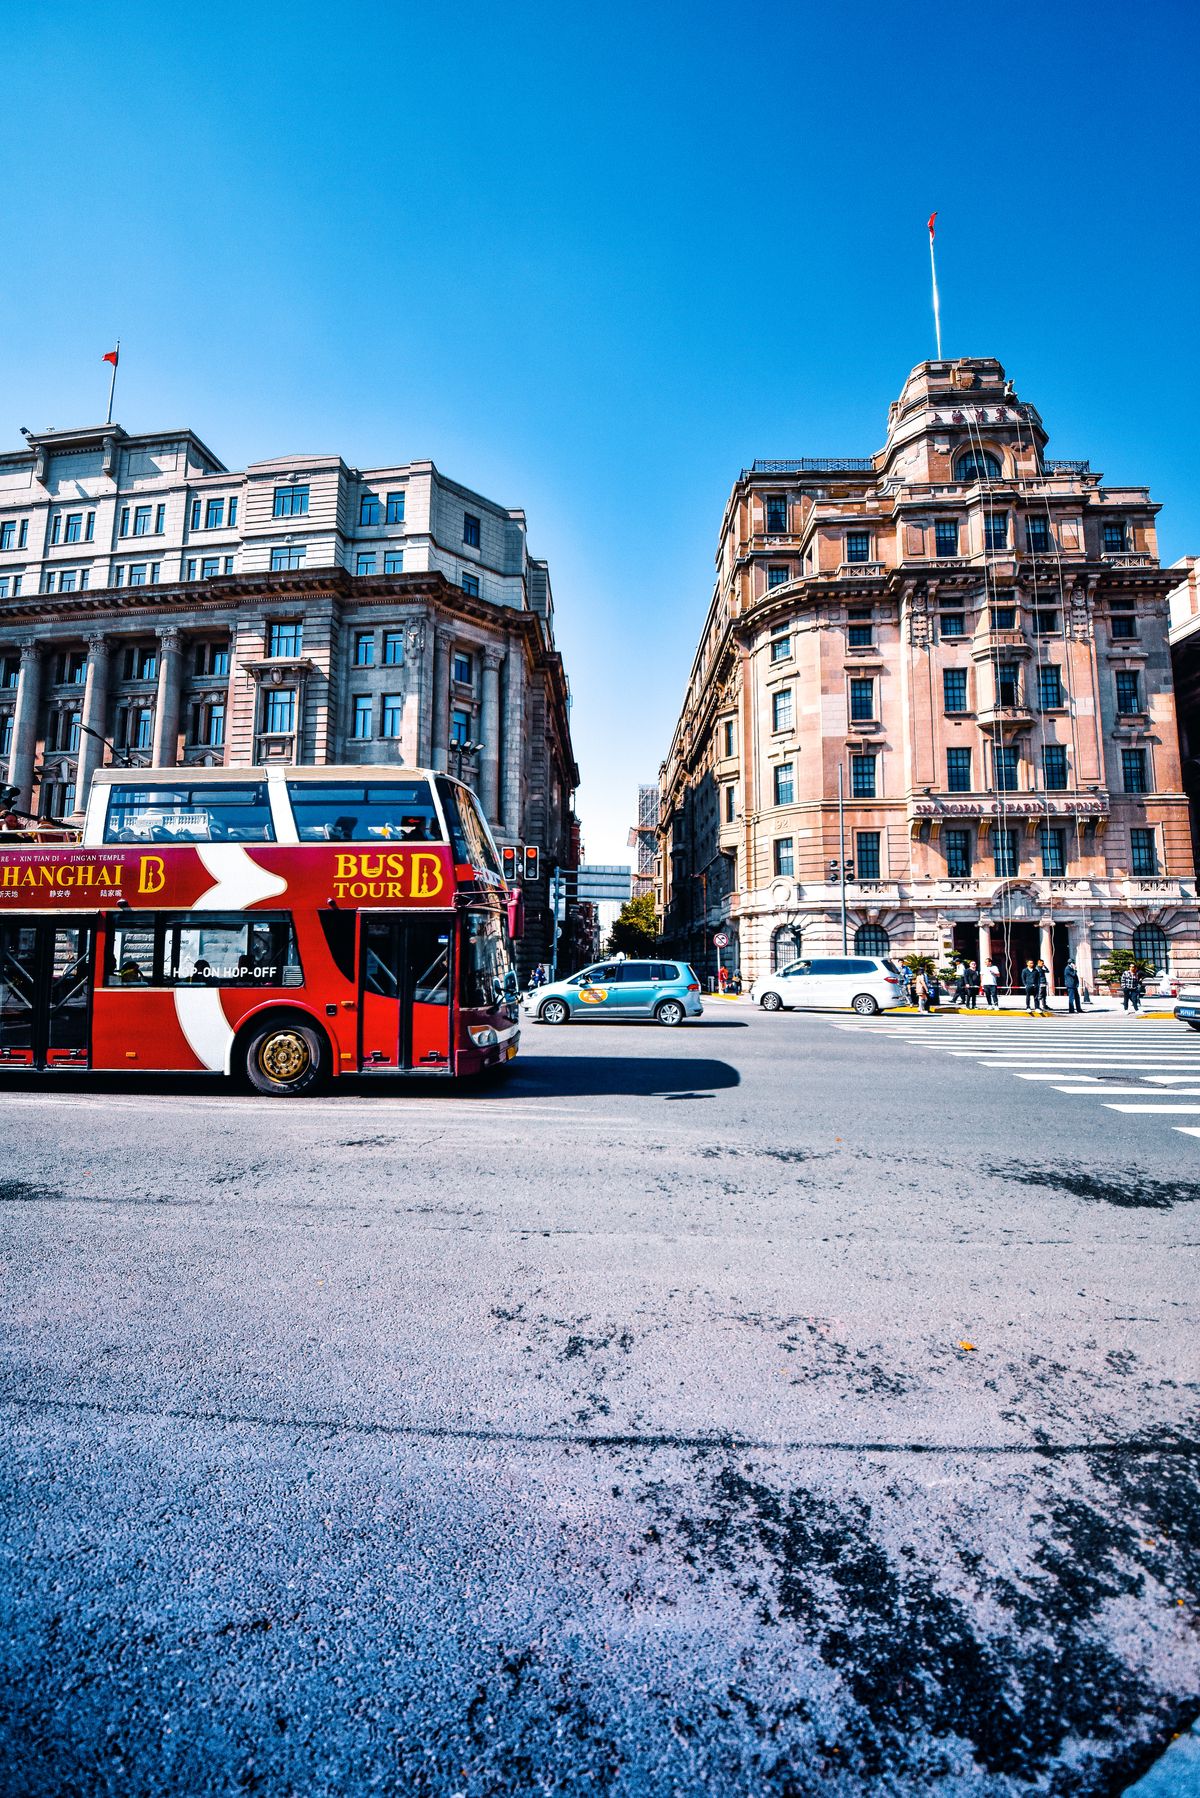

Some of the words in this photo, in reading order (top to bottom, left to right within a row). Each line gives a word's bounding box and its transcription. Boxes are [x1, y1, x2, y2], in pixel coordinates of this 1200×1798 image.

[915, 804, 984, 815] SHANGHAI
[991, 803, 1057, 814] CLEARING
[1065, 802, 1107, 813] HOUSE
[333, 853, 405, 878] BUS
[0, 865, 124, 887] HANGHAI
[49, 890, 71, 898] 静安寺
[333, 882, 404, 898] TOUR
[173, 967, 220, 978] HOP-ON
[223, 967, 277, 978] HOP-OFF
